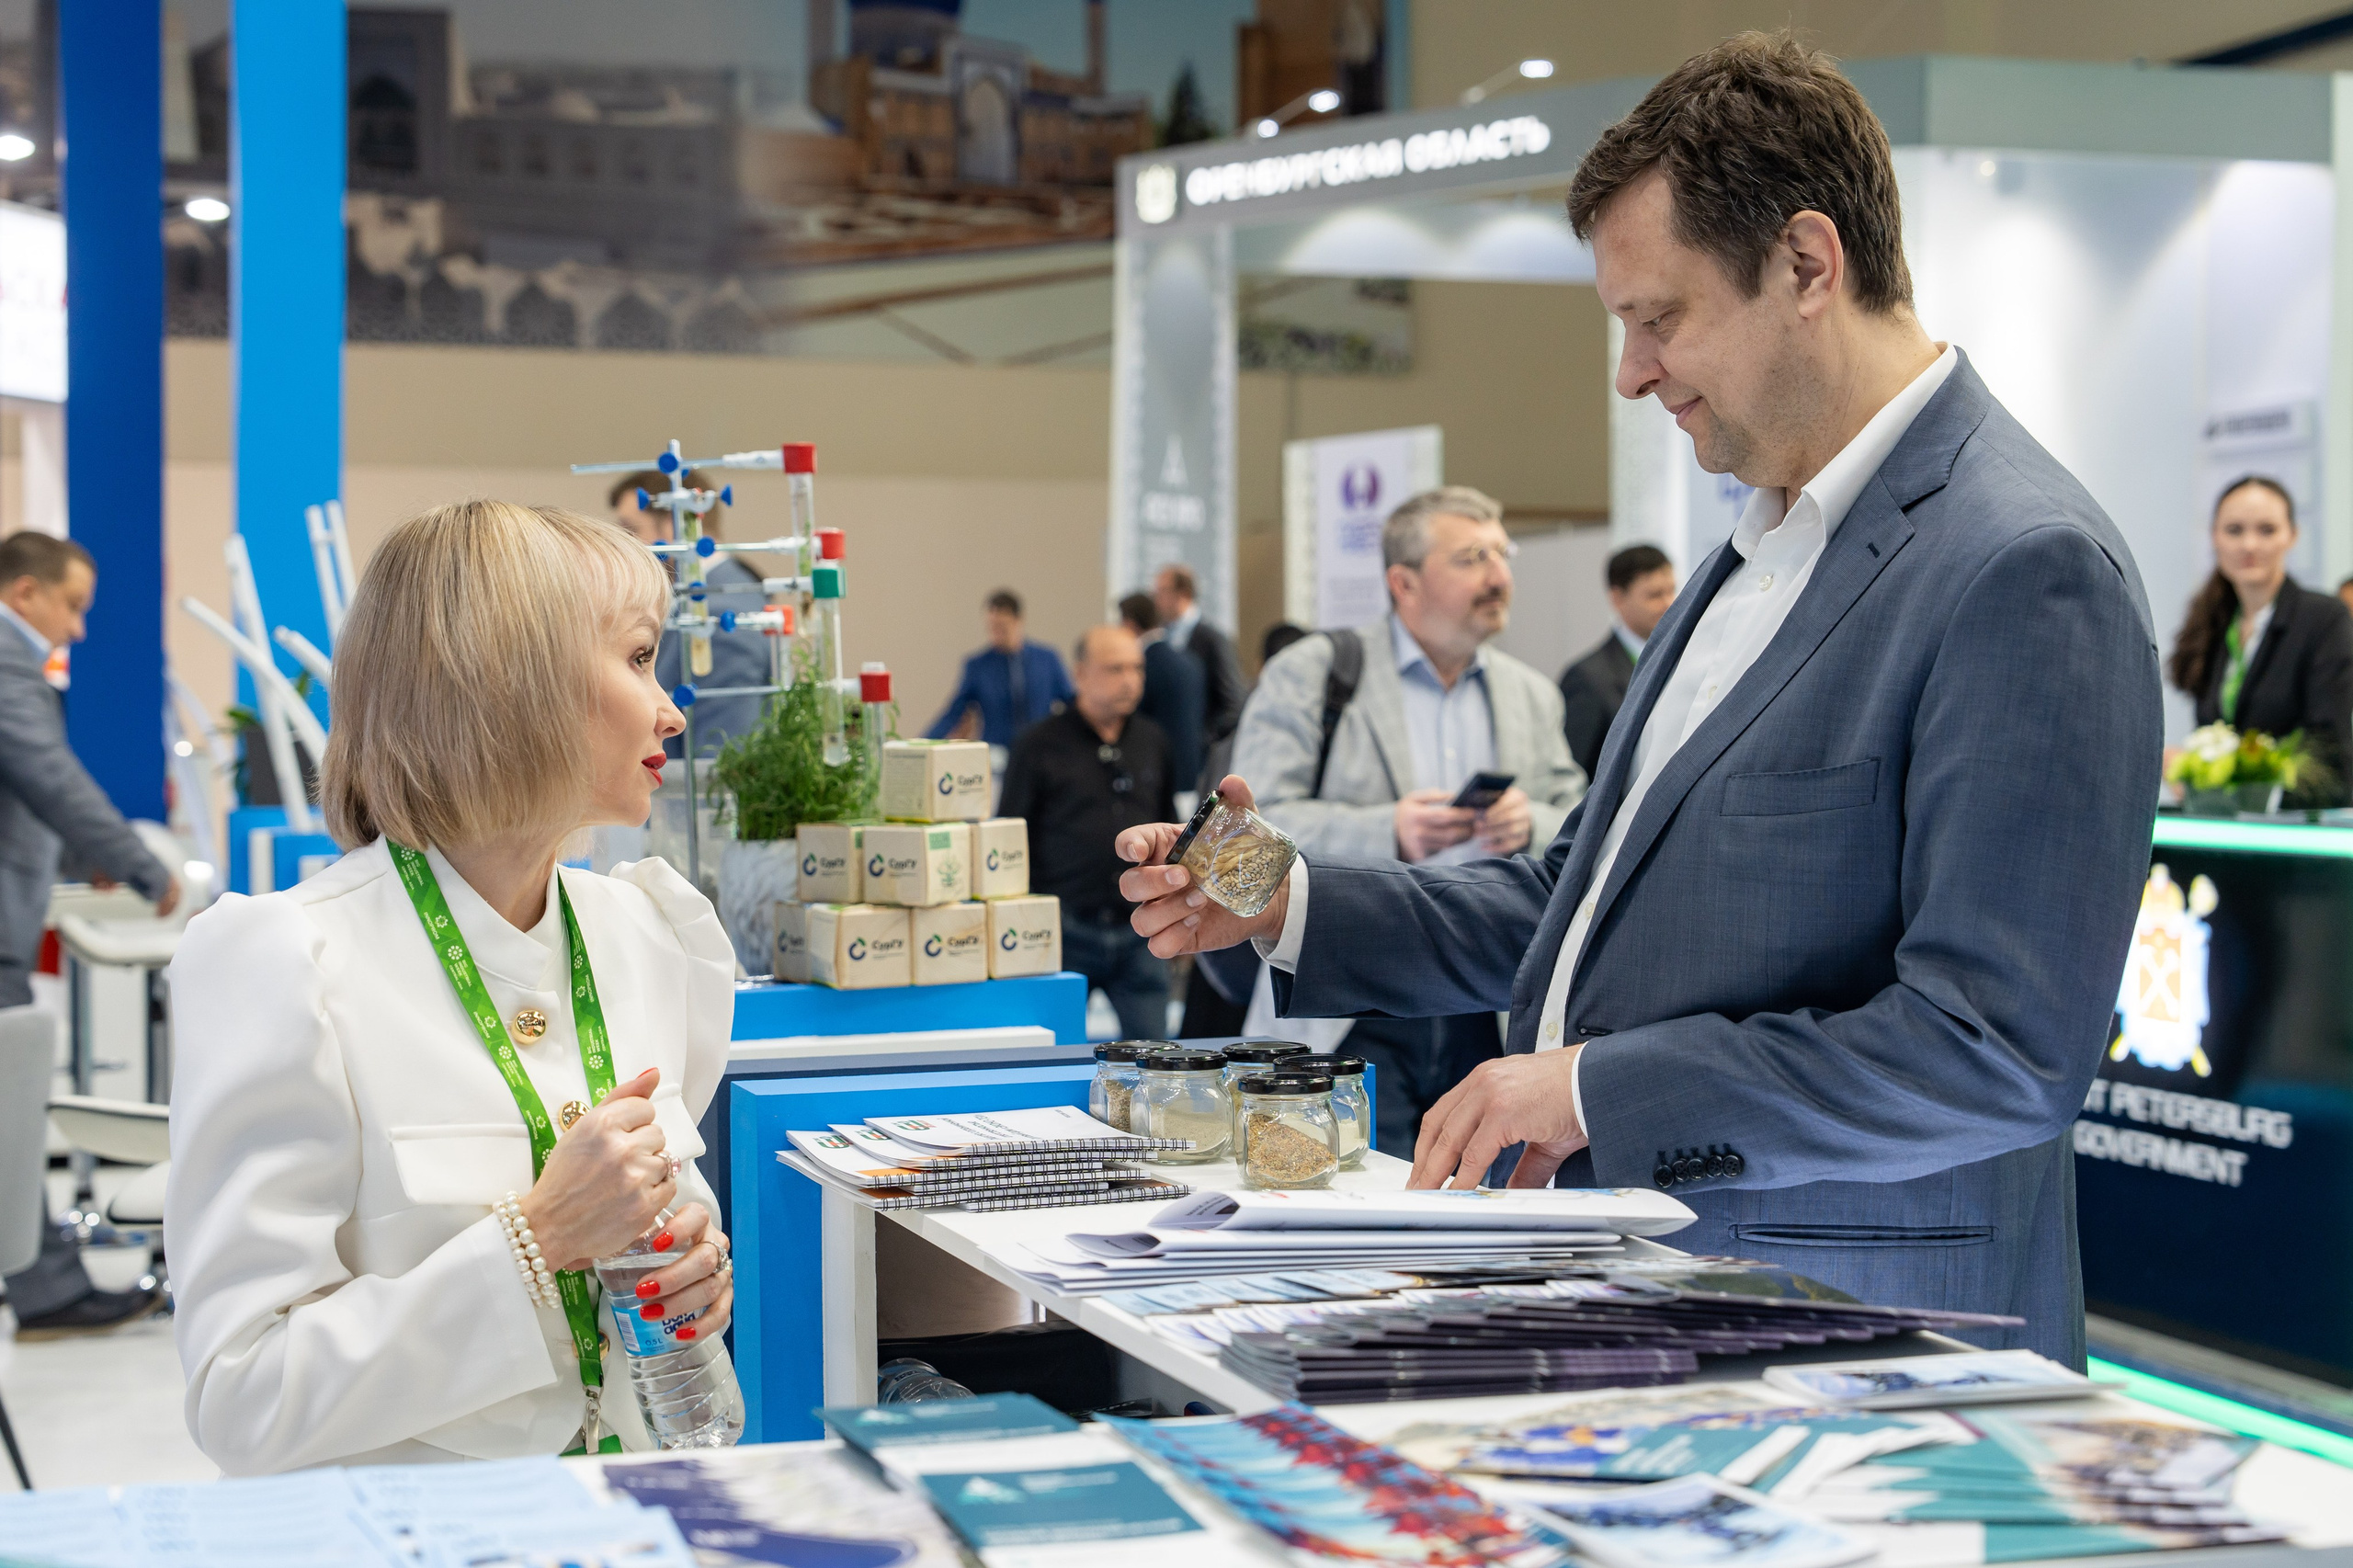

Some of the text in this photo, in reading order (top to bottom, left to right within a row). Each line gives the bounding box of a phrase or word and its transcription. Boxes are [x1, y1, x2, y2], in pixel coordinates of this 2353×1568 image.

[424, 912, 440, 939] INNOPROM
[473, 1011, 490, 1039] INNOPROM
[2109, 1081, 2294, 1149] PETERSBURG
[2073, 1119, 2250, 1187] GOVERNMENT
[645, 1338, 658, 1346] 0,5
